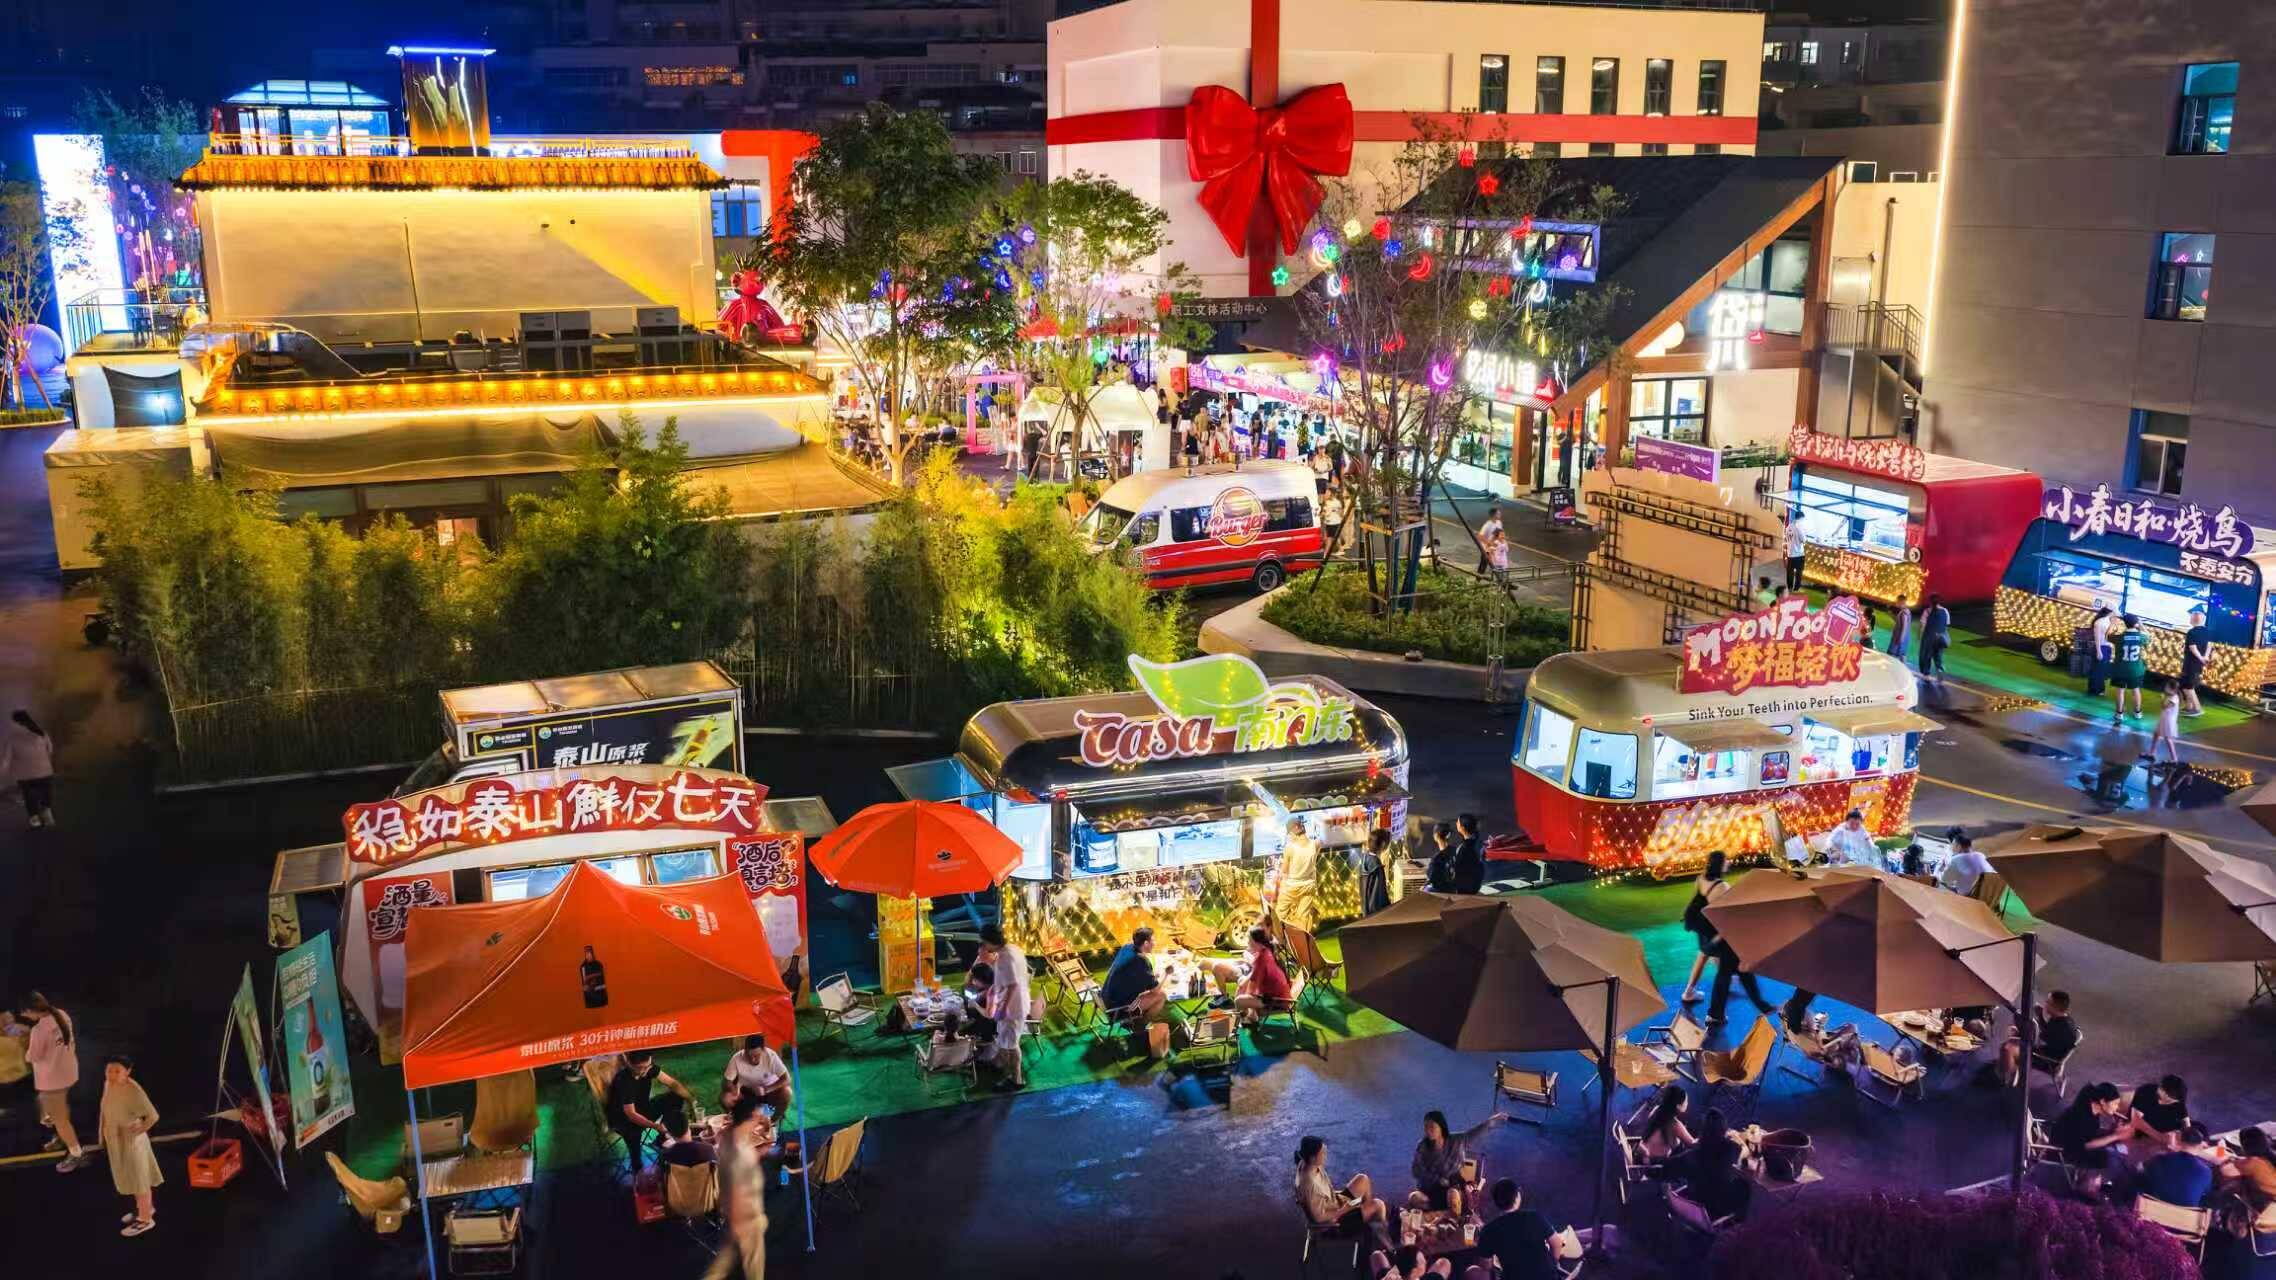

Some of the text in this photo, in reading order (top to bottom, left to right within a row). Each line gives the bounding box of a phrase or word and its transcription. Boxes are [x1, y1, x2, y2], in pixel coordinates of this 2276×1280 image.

[1210, 511, 1268, 538] Burger
[2122, 644, 2141, 661] 12
[1726, 642, 1861, 691] 梦福轻饮
[1688, 693, 1873, 721] Sink Your Teeth into Perfection.
[1073, 708, 1215, 768] Casa
[552, 742, 651, 768] 泰山原浆
